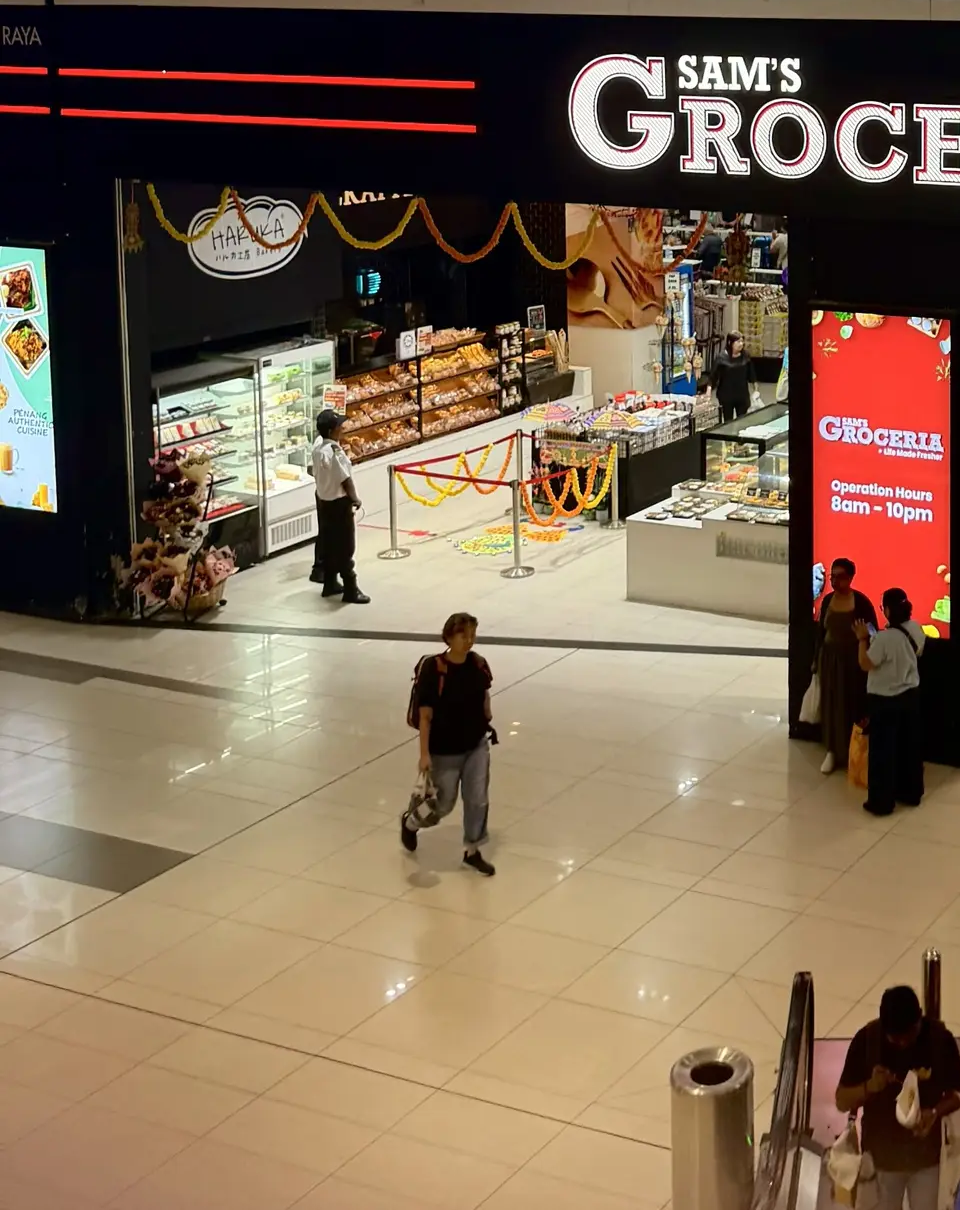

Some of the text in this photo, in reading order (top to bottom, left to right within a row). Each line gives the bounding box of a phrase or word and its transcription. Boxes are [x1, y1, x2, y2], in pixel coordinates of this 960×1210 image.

[2, 25, 43, 46] RAYA
[678, 54, 802, 95] SAM'S
[16, 426, 49, 437] CUISINE
[819, 415, 945, 453] GROCERIA
[831, 479, 933, 502] Operation Hours
[831, 495, 871, 515] 8am
[886, 501, 933, 524] 10pm
